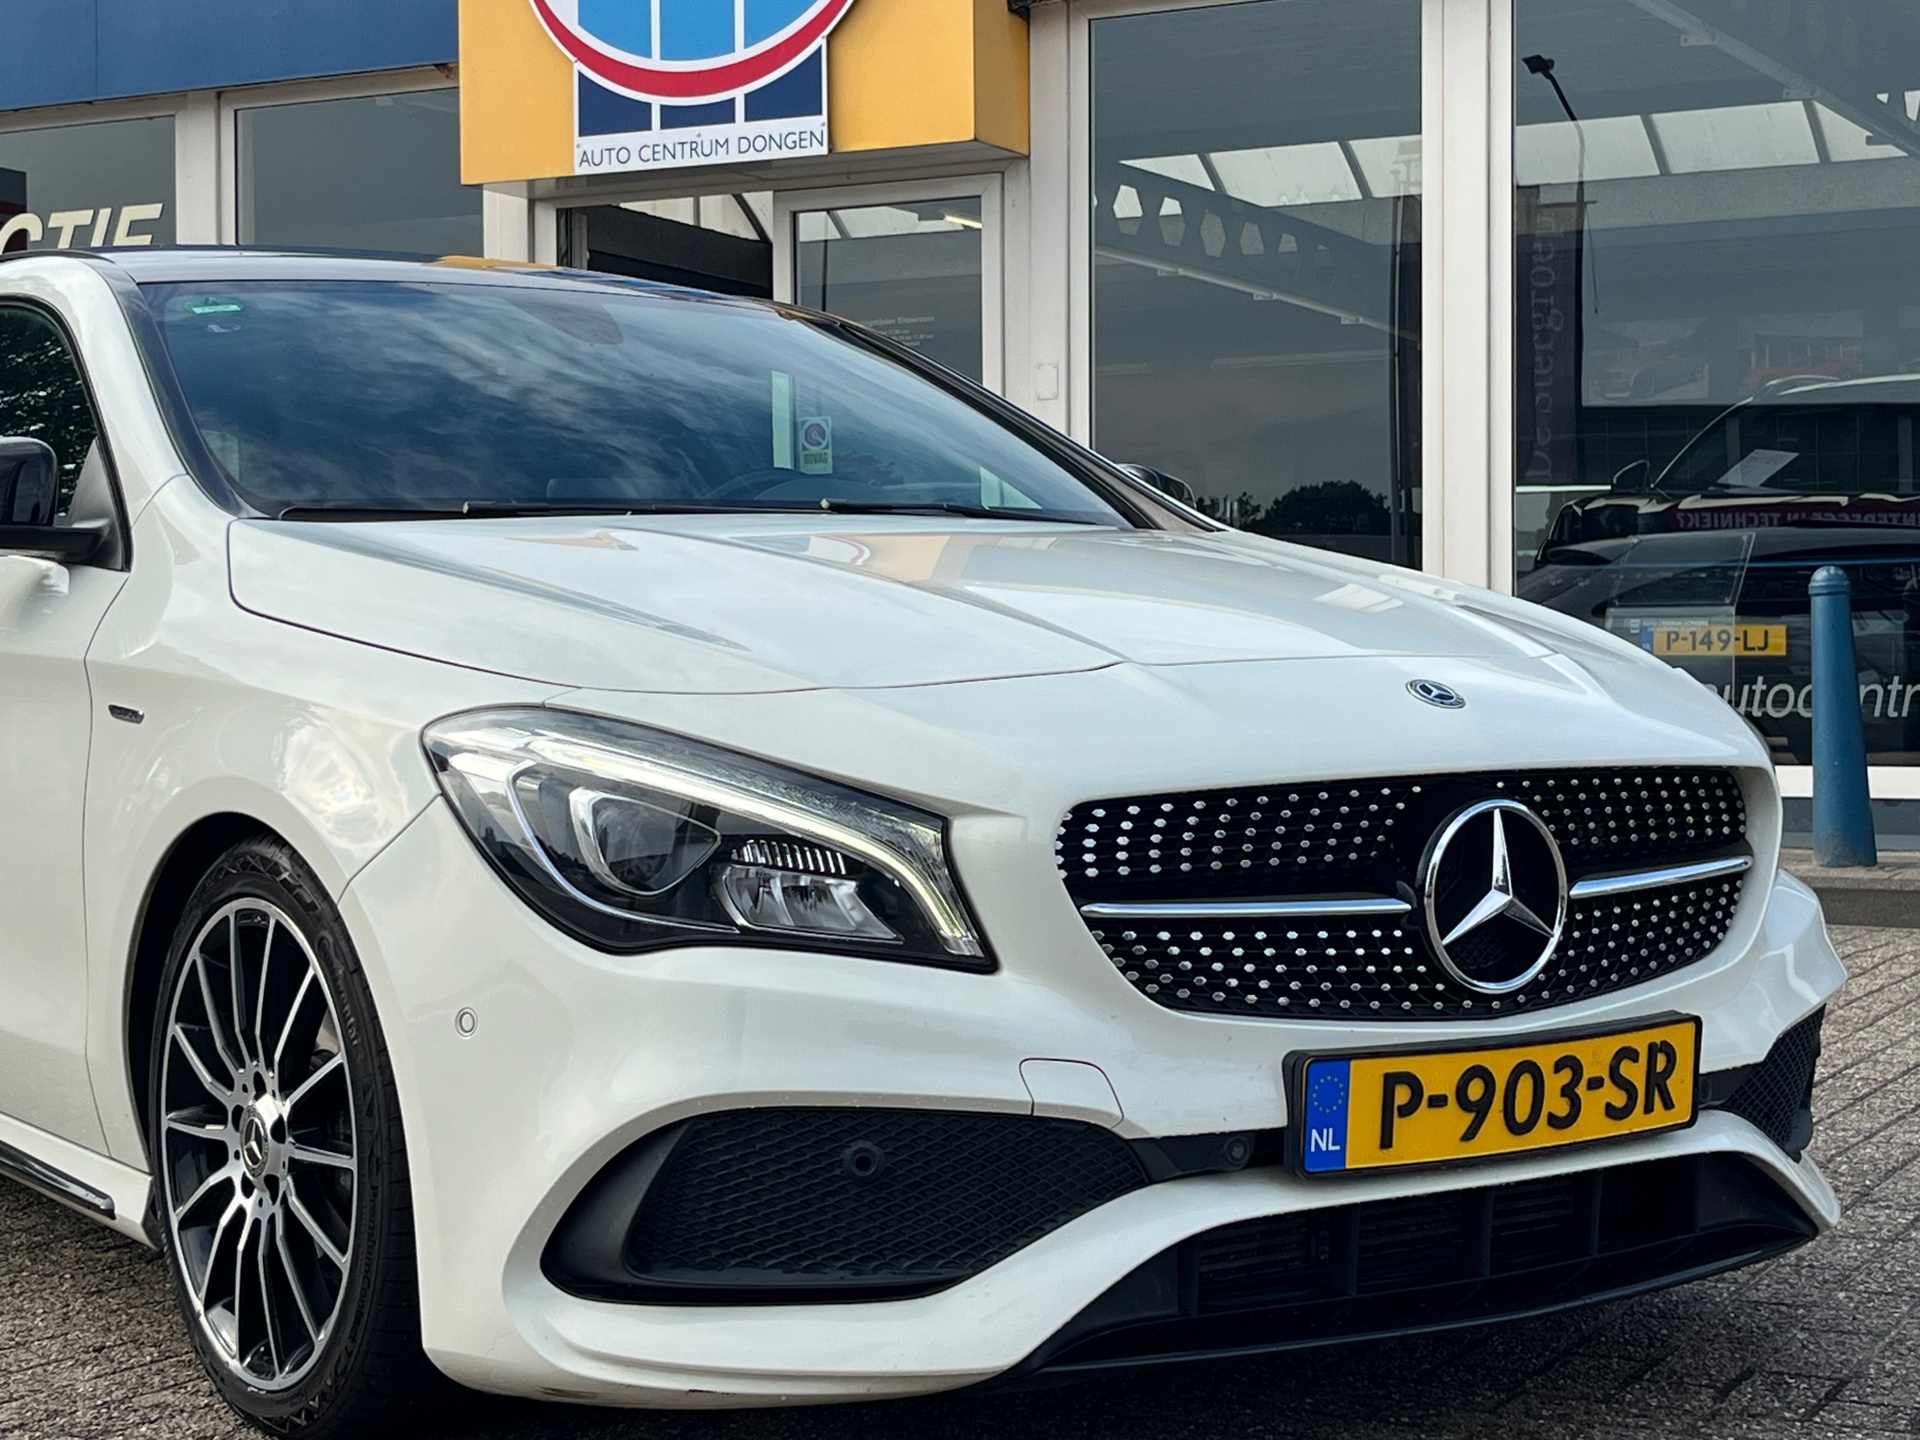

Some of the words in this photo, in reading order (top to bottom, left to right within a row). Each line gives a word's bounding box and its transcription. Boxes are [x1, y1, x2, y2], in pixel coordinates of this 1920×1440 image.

[578, 146, 631, 168] AUTO
[638, 138, 730, 163] CENTRUM
[738, 129, 825, 155] DONGEN
[1666, 629, 1769, 651] P-149-LJ
[1311, 1127, 1341, 1153] NL
[1379, 1039, 1678, 1150] P-903-SR
